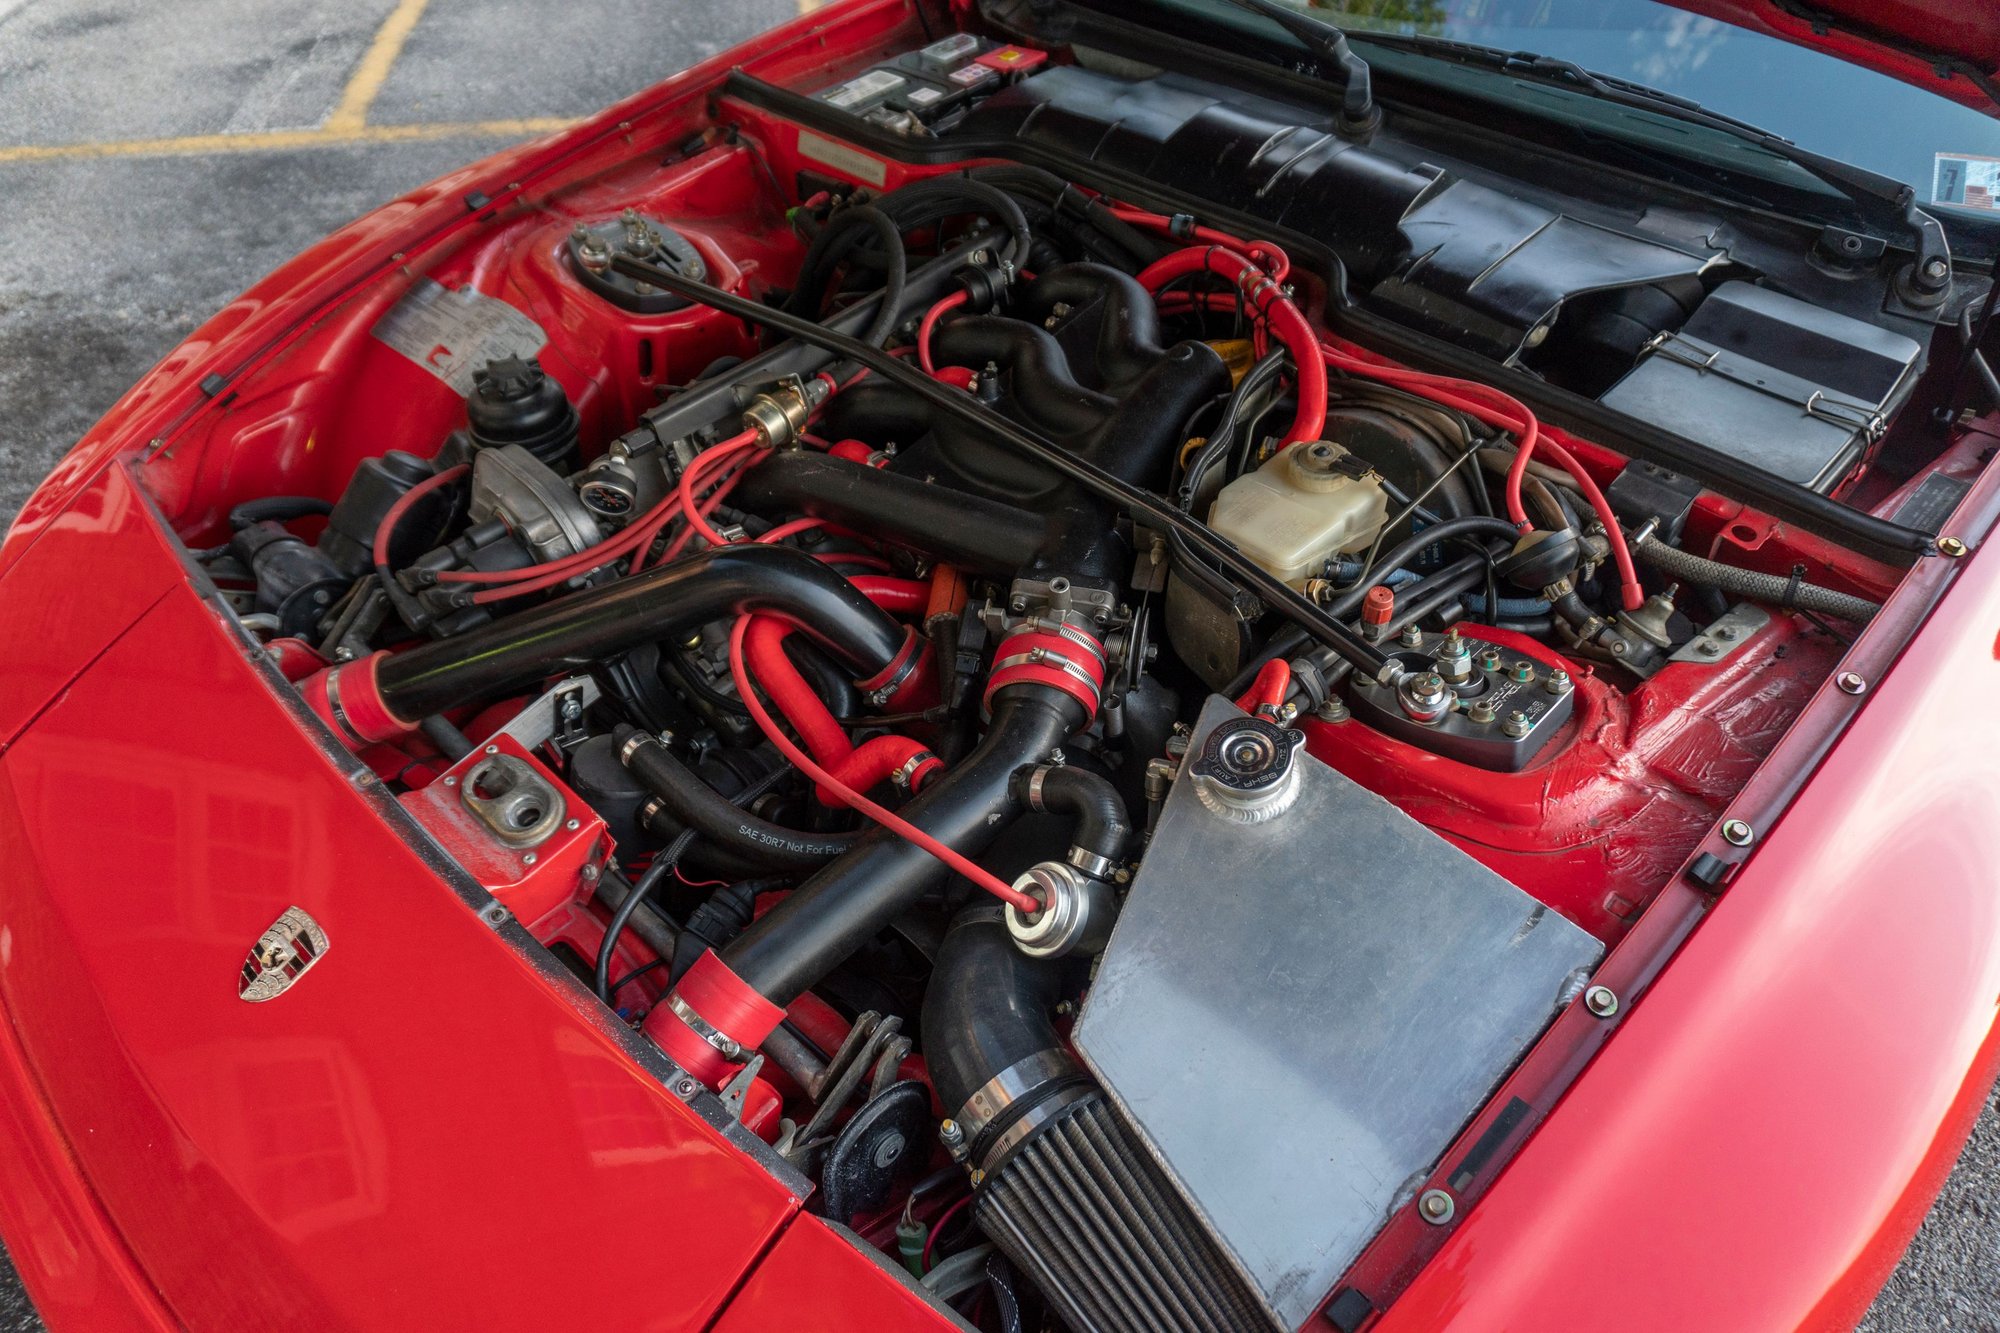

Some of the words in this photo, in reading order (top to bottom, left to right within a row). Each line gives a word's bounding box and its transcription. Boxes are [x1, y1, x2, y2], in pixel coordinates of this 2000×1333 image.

[1214, 767, 1232, 780] AUF
[738, 824, 759, 841] SAE
[759, 833, 785, 849] 30R7
[786, 841, 804, 853] Not
[806, 844, 823, 855] For
[825, 844, 847, 855] Fuel
